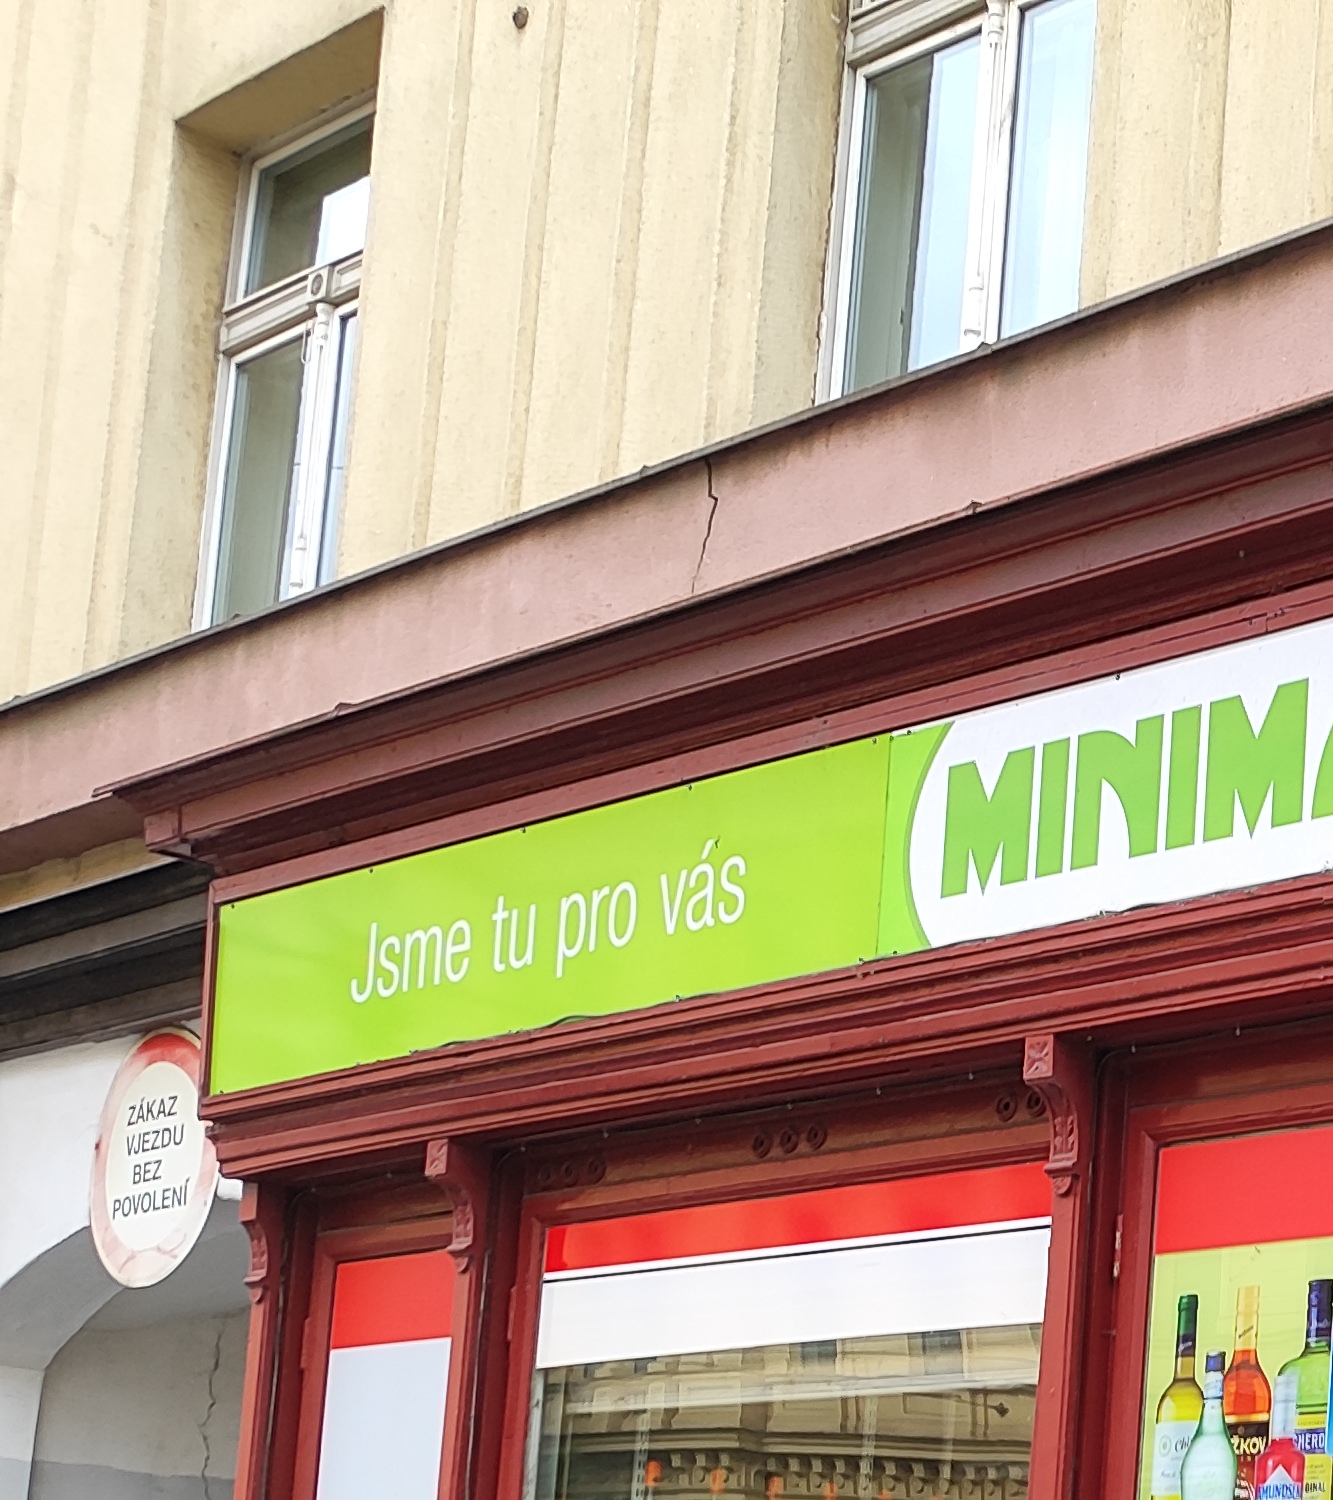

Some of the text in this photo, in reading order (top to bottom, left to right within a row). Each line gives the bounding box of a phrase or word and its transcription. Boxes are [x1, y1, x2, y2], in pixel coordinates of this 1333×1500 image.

[350, 838, 747, 1003] Jsme tu pro vás
[126, 1095, 178, 1127] ZÁKAZ
[126, 1123, 185, 1156] VJEZDU
[132, 1159, 163, 1185] BEZ
[112, 1177, 191, 1220] POVOLENÍ
